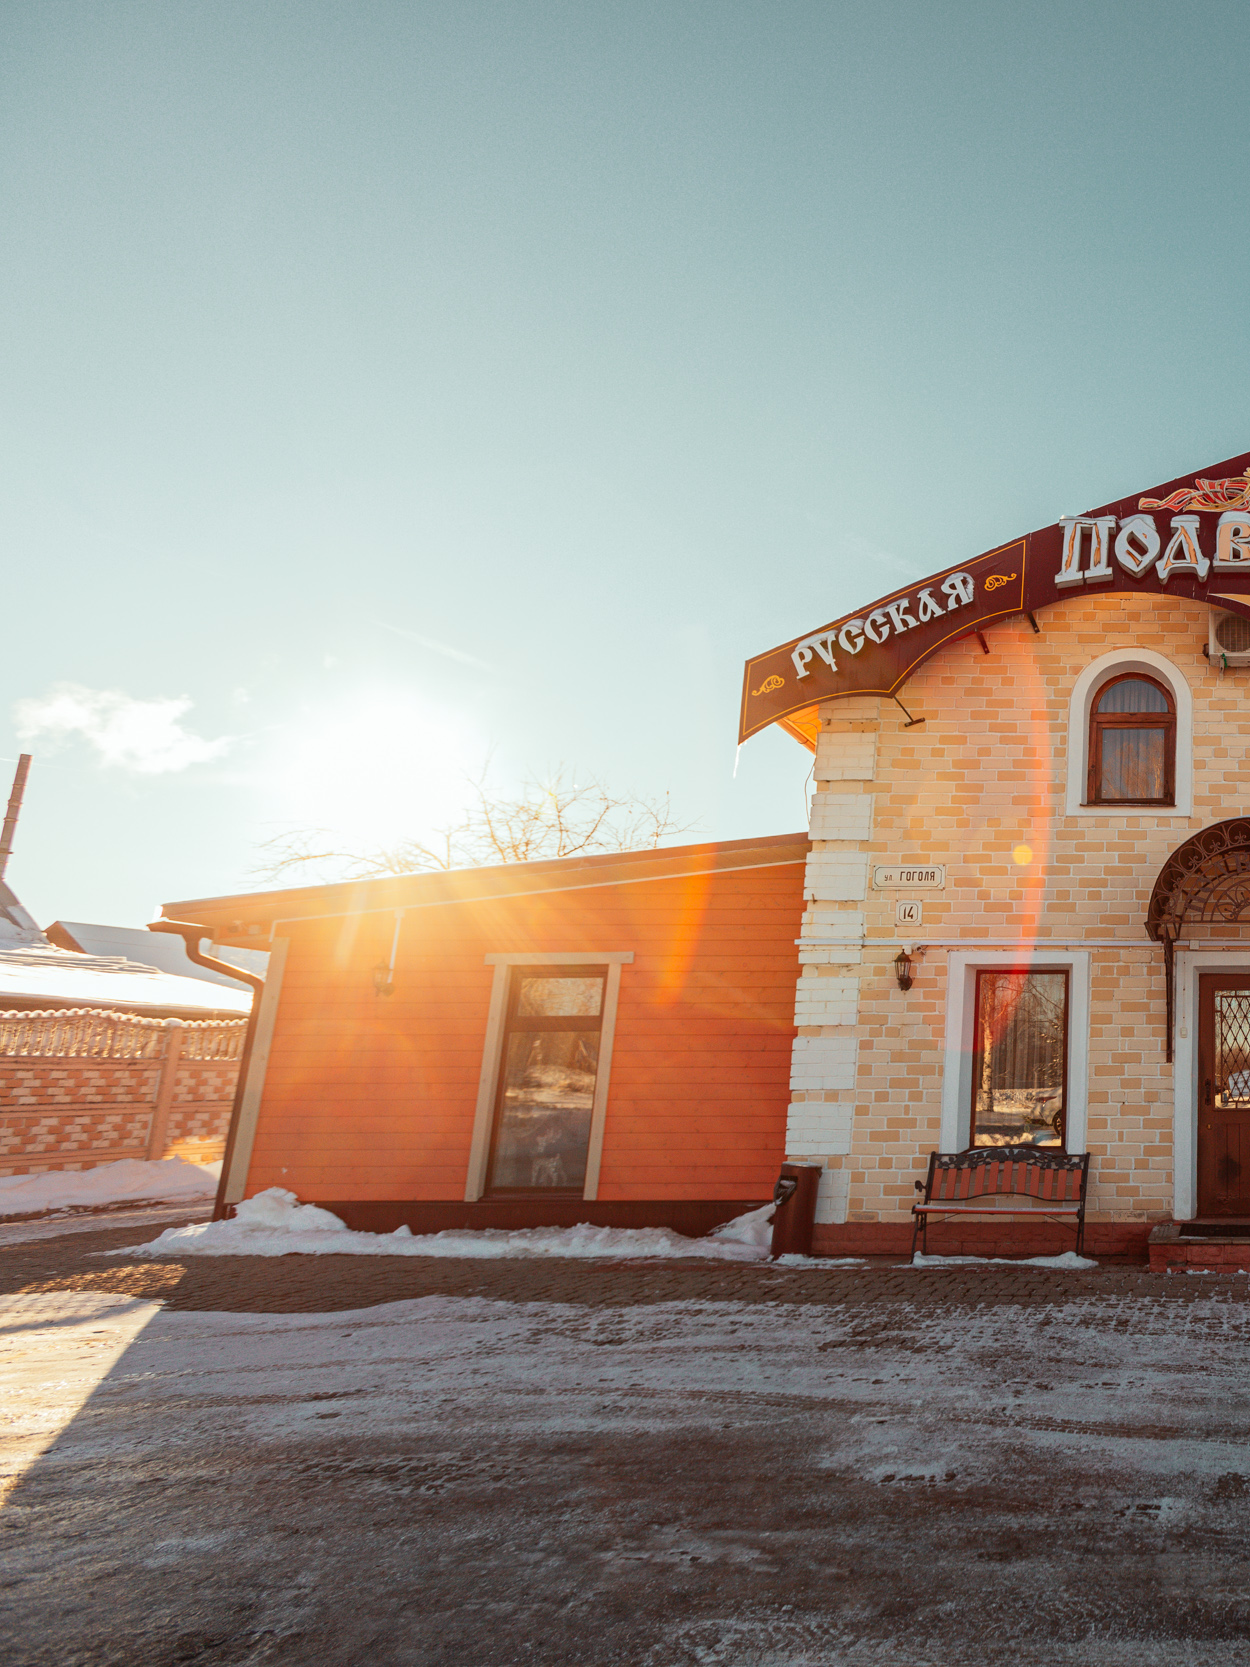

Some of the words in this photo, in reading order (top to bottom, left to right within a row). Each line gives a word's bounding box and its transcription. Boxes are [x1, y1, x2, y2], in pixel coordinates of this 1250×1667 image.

[790, 574, 975, 680] РУССКАЯ
[899, 871, 935, 881] ГОГОЛЯ
[903, 906, 914, 920] 14
